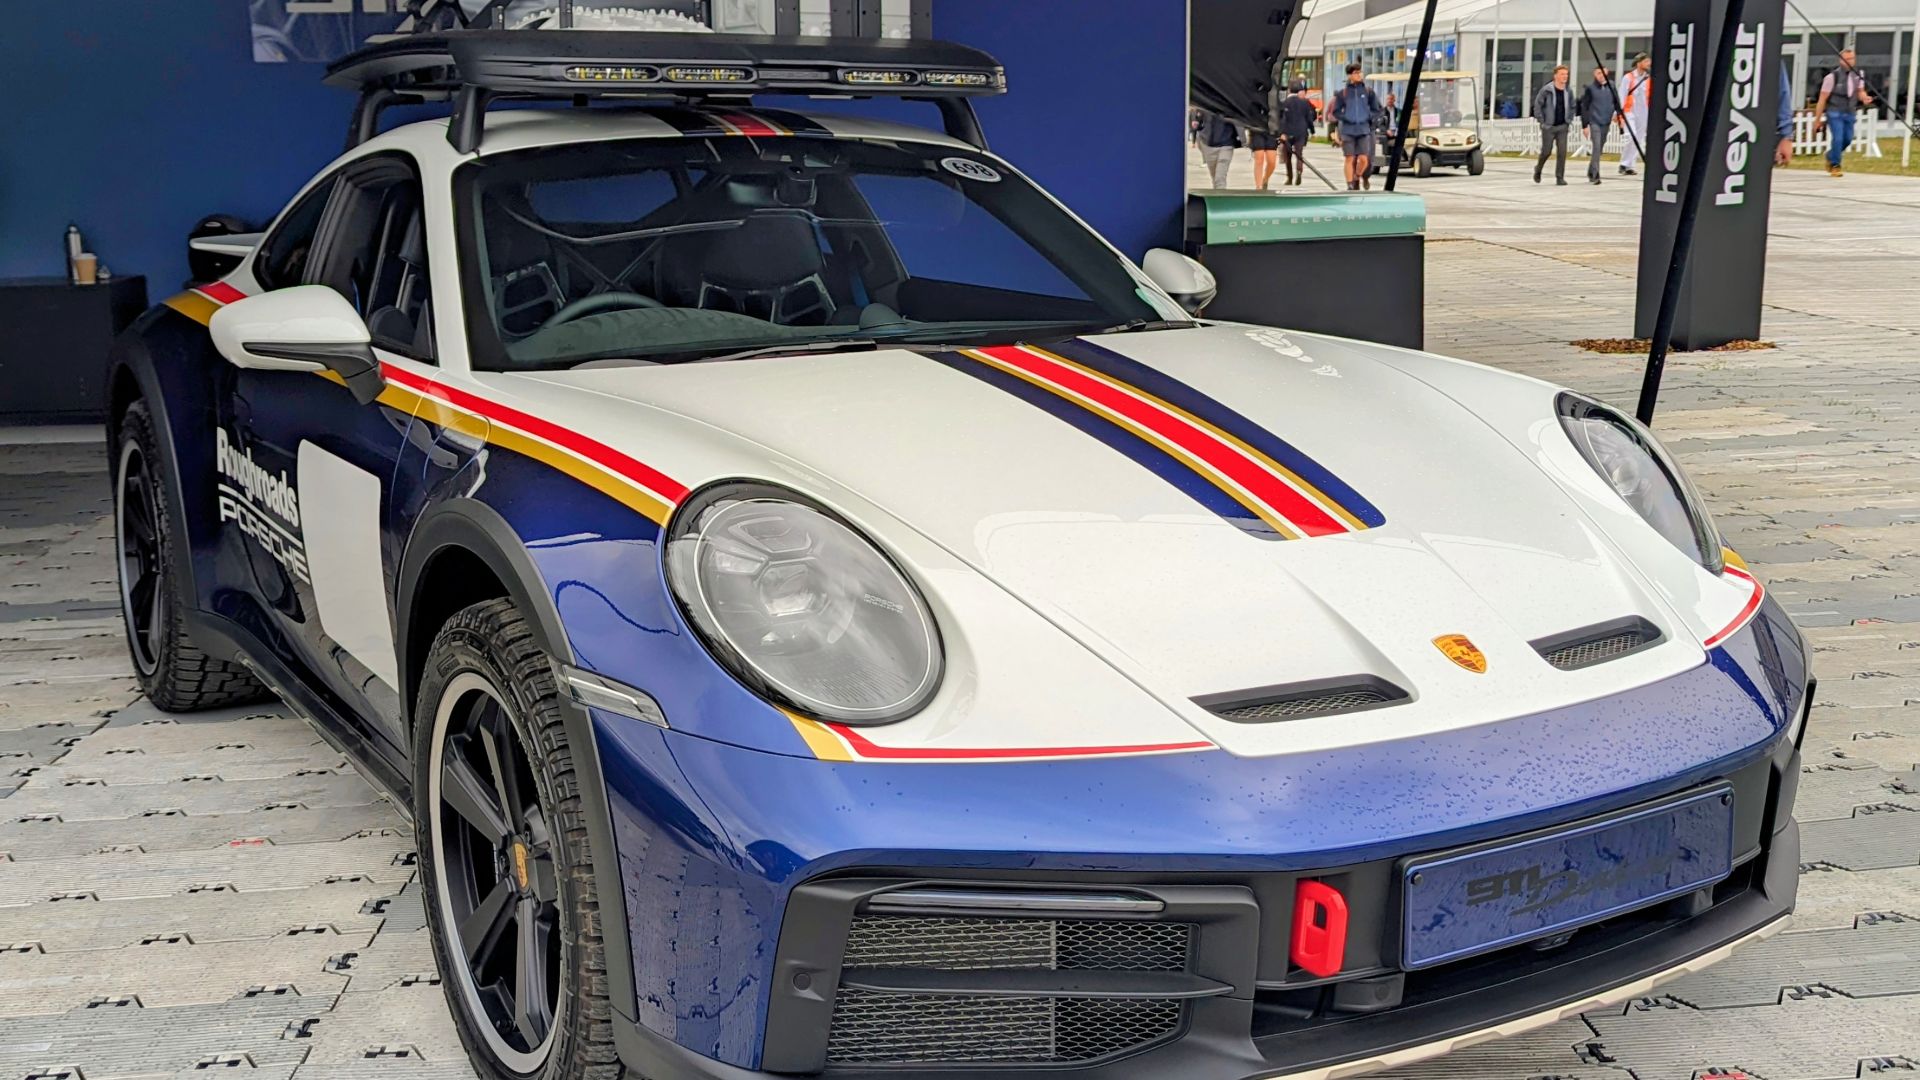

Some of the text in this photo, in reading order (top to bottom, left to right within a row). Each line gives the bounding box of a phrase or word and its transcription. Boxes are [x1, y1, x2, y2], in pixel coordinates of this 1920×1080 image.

[1656, 23, 1688, 203] heycar
[1715, 23, 1758, 205] heycar
[951, 161, 994, 177] 698
[1228, 213, 1404, 228] DRIVE ELECTRIFIED
[217, 427, 299, 527] Roughroads
[219, 496, 311, 585] PORSCHE
[1466, 864, 1541, 906] 911
